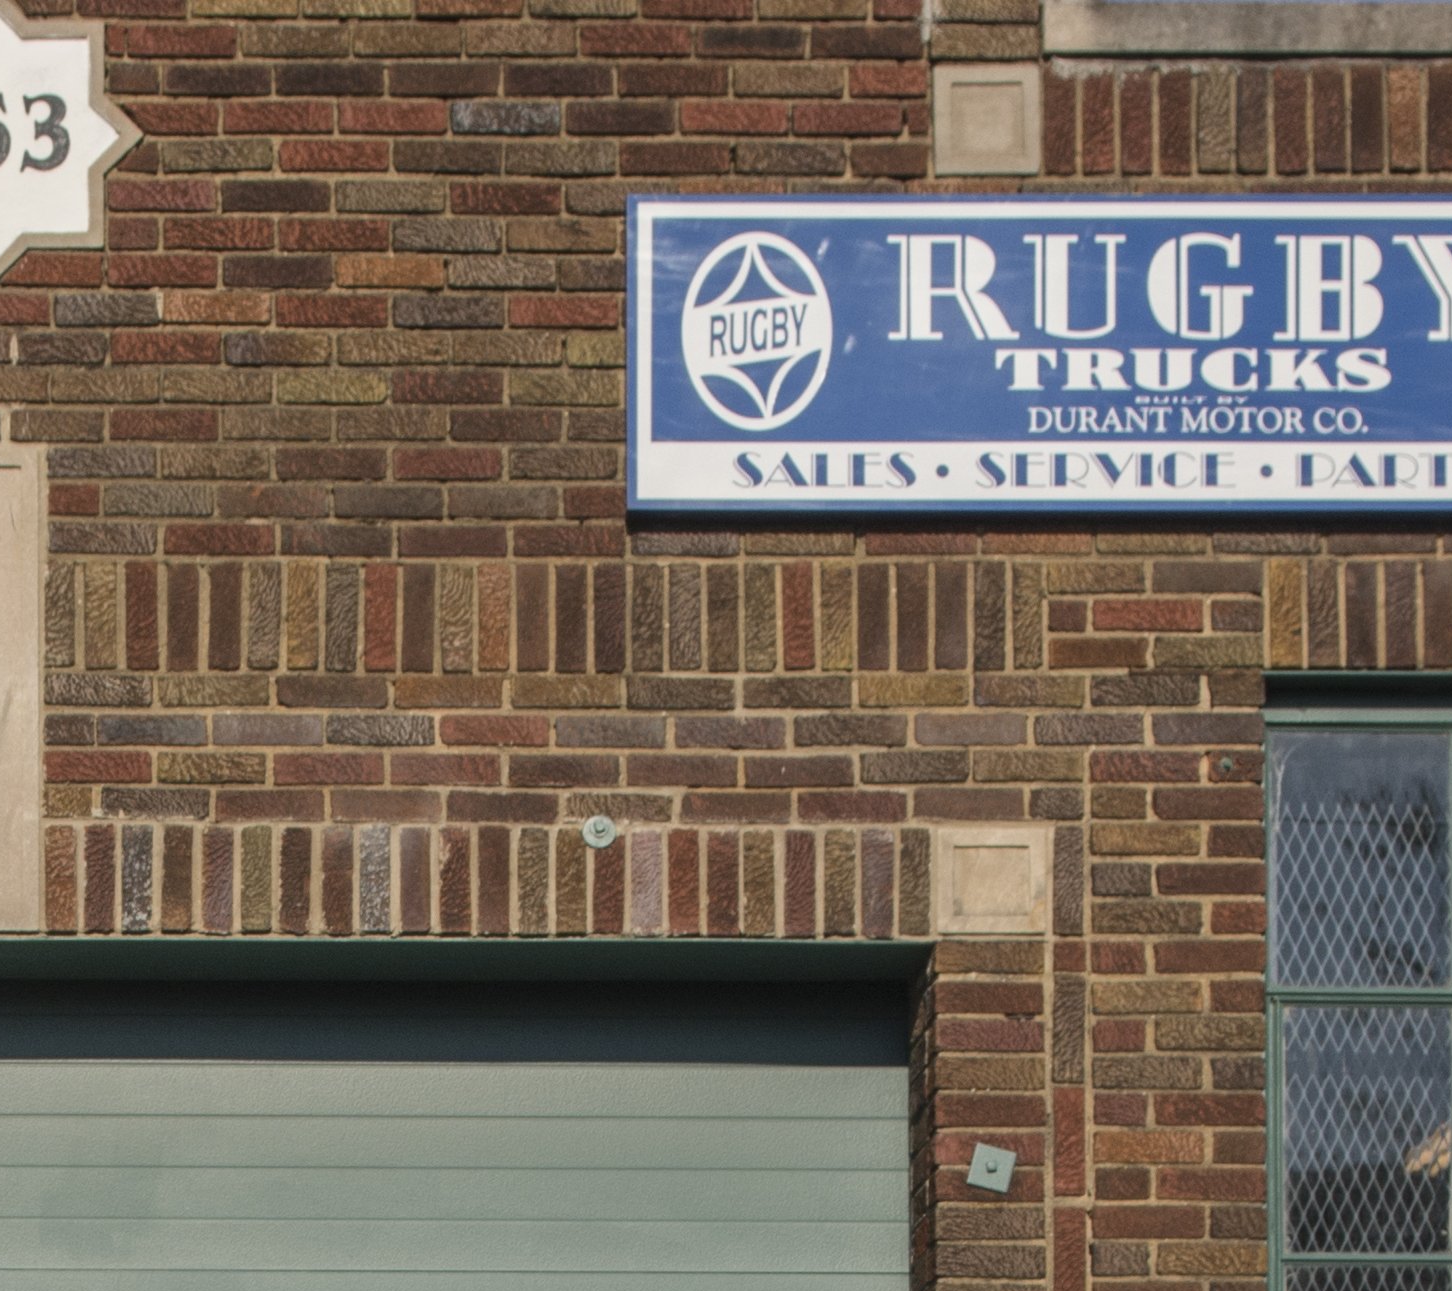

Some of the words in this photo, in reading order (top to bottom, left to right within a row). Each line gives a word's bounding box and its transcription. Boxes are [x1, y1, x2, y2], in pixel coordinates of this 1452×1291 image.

[709, 303, 808, 358] RUGBY
[995, 347, 1392, 393] TRUCKS
[1027, 406, 1173, 434] DURANT
[1180, 407, 1304, 434] MOTOR
[1312, 407, 1369, 434] CO.
[732, 451, 916, 489] SALES
[975, 451, 1236, 489] SERVICE
